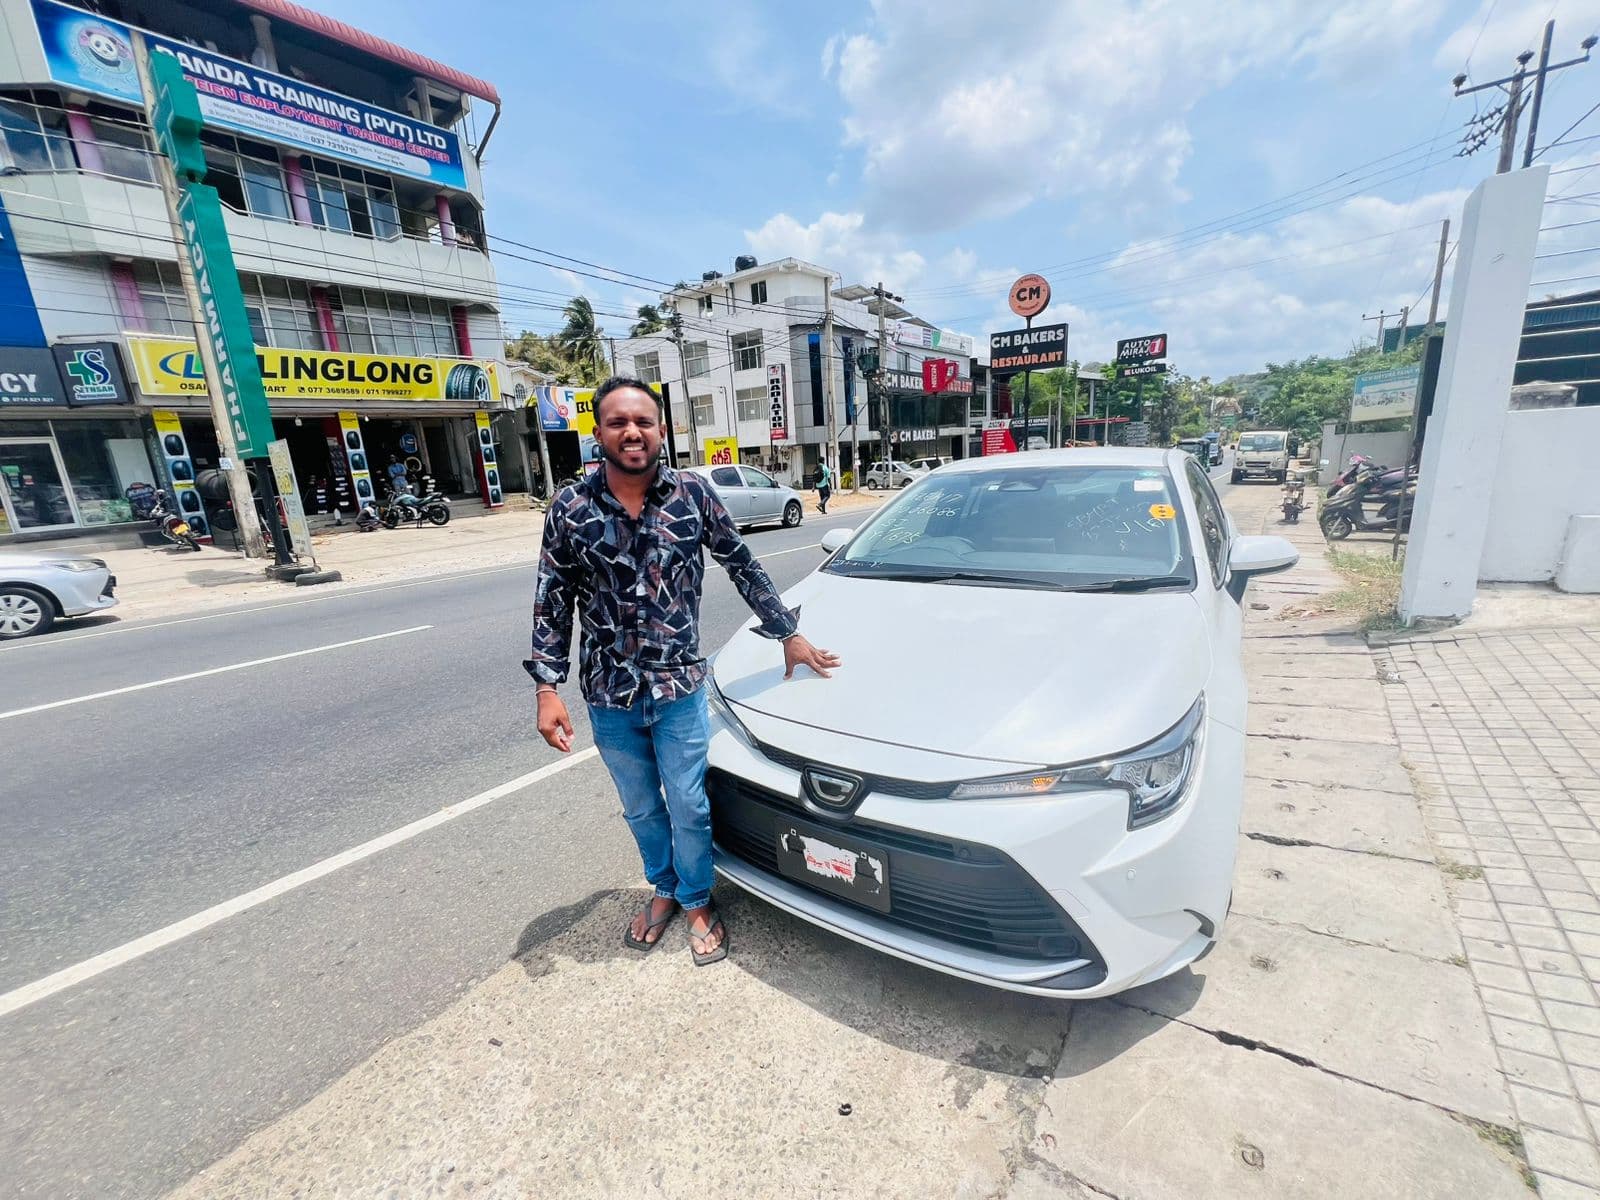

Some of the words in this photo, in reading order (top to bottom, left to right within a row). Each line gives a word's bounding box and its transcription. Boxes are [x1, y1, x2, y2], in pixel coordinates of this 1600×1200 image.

[155, 45, 252, 90] ANDA
[253, 76, 361, 123] TRAINING
[364, 112, 414, 143] (PVT)
[416, 129, 447, 149] LTD
[239, 91, 342, 131] EMPLOYMENT
[344, 123, 405, 151] TRAINING
[405, 142, 450, 164] CENTER
[1016, 286, 1041, 302] CM
[185, 218, 246, 442] PHARMACY
[991, 335, 1011, 349] CM
[1013, 328, 1065, 346] BAKERS
[1022, 345, 1029, 354] &
[1123, 340, 1150, 350] AUTO
[991, 351, 1063, 368] RESTAURANT
[256, 354, 433, 384] LINGLONG
[1131, 366, 1157, 375] LUKOIL
[886, 372, 898, 388] CM
[900, 375, 924, 390] BAKER
[769, 378, 782, 428] RADIATOR
[900, 430, 911, 442] CM
